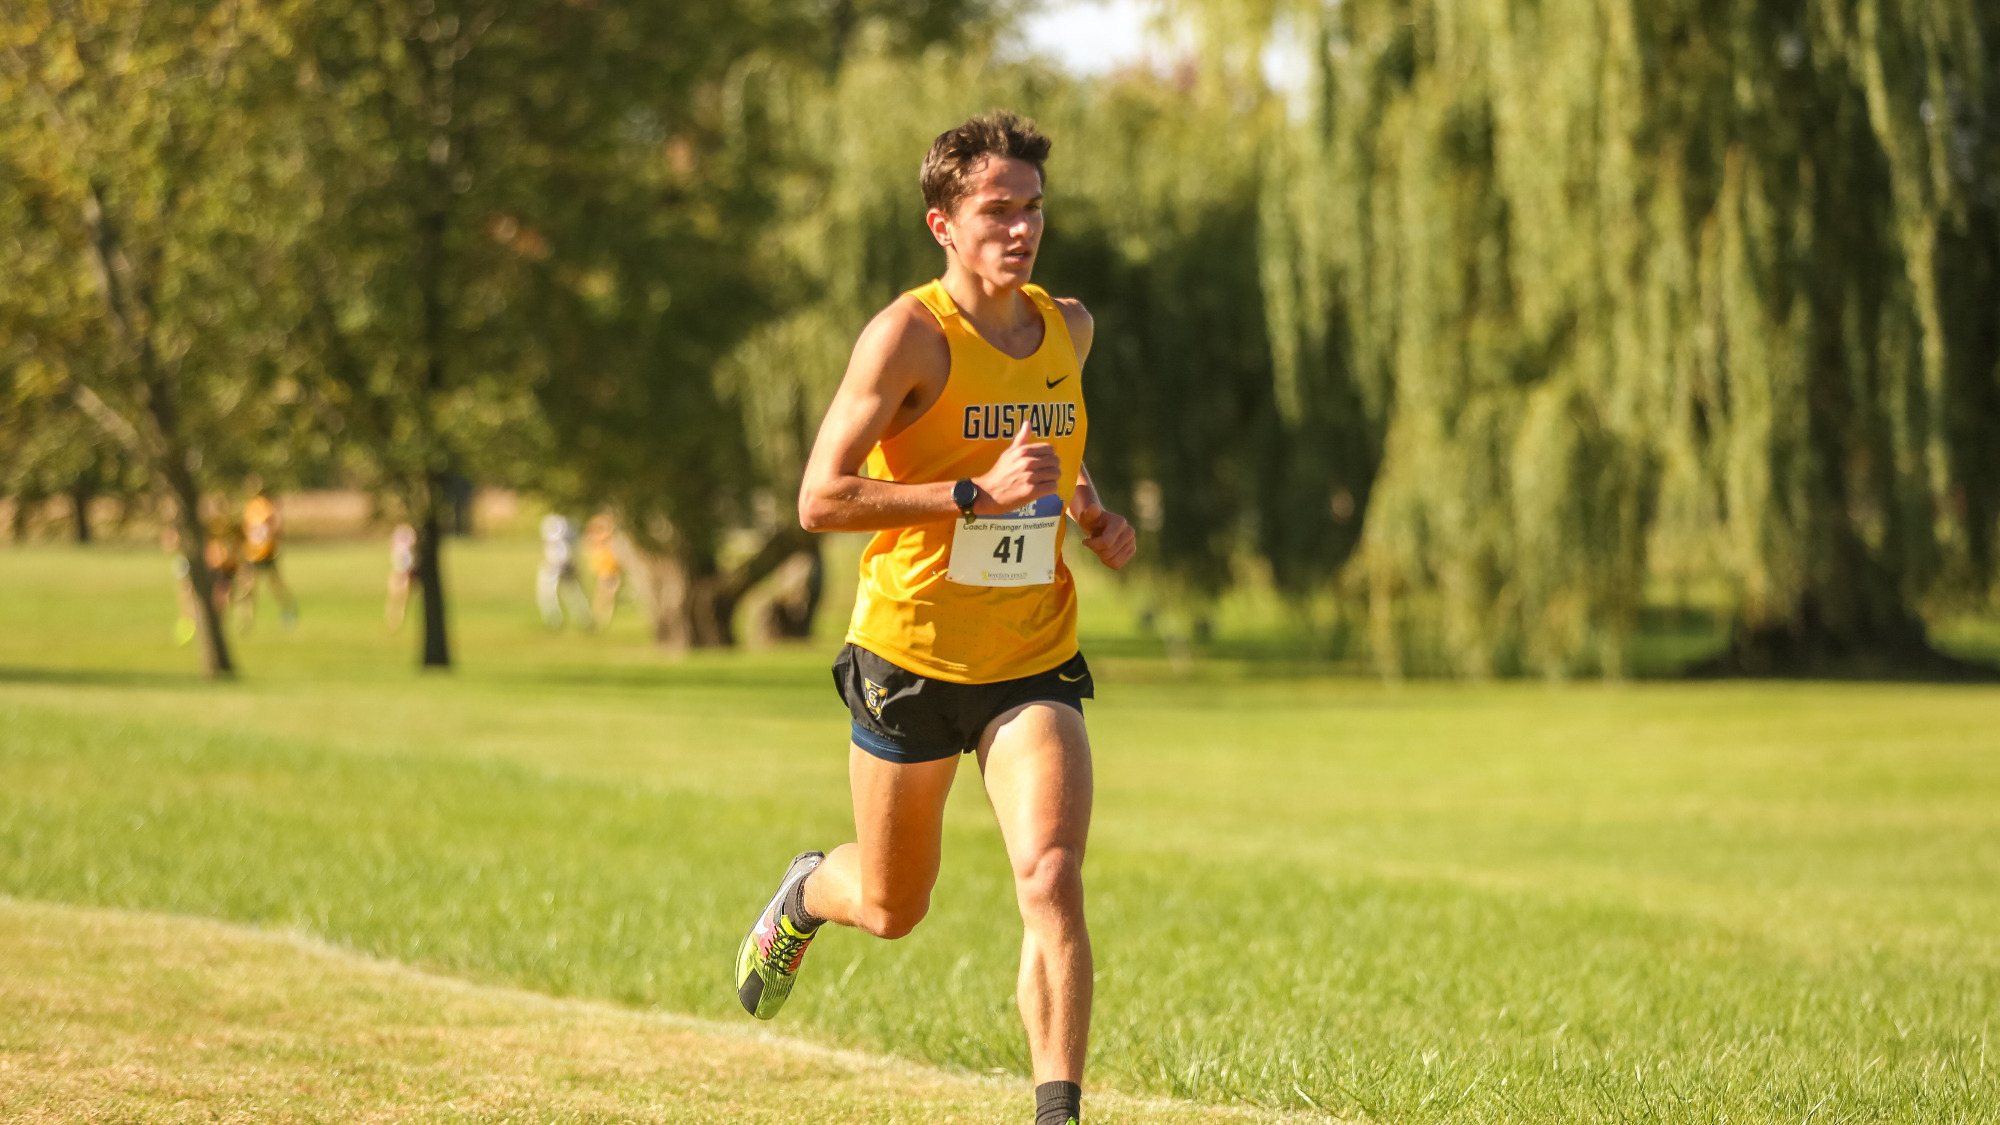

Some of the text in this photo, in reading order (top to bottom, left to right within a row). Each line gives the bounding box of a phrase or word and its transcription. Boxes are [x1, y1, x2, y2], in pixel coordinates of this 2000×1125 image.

[963, 403, 1076, 440] GUSTAVUS
[963, 523, 988, 531] Coach
[990, 523, 1021, 533] Finanger
[993, 535, 1025, 563] 41
